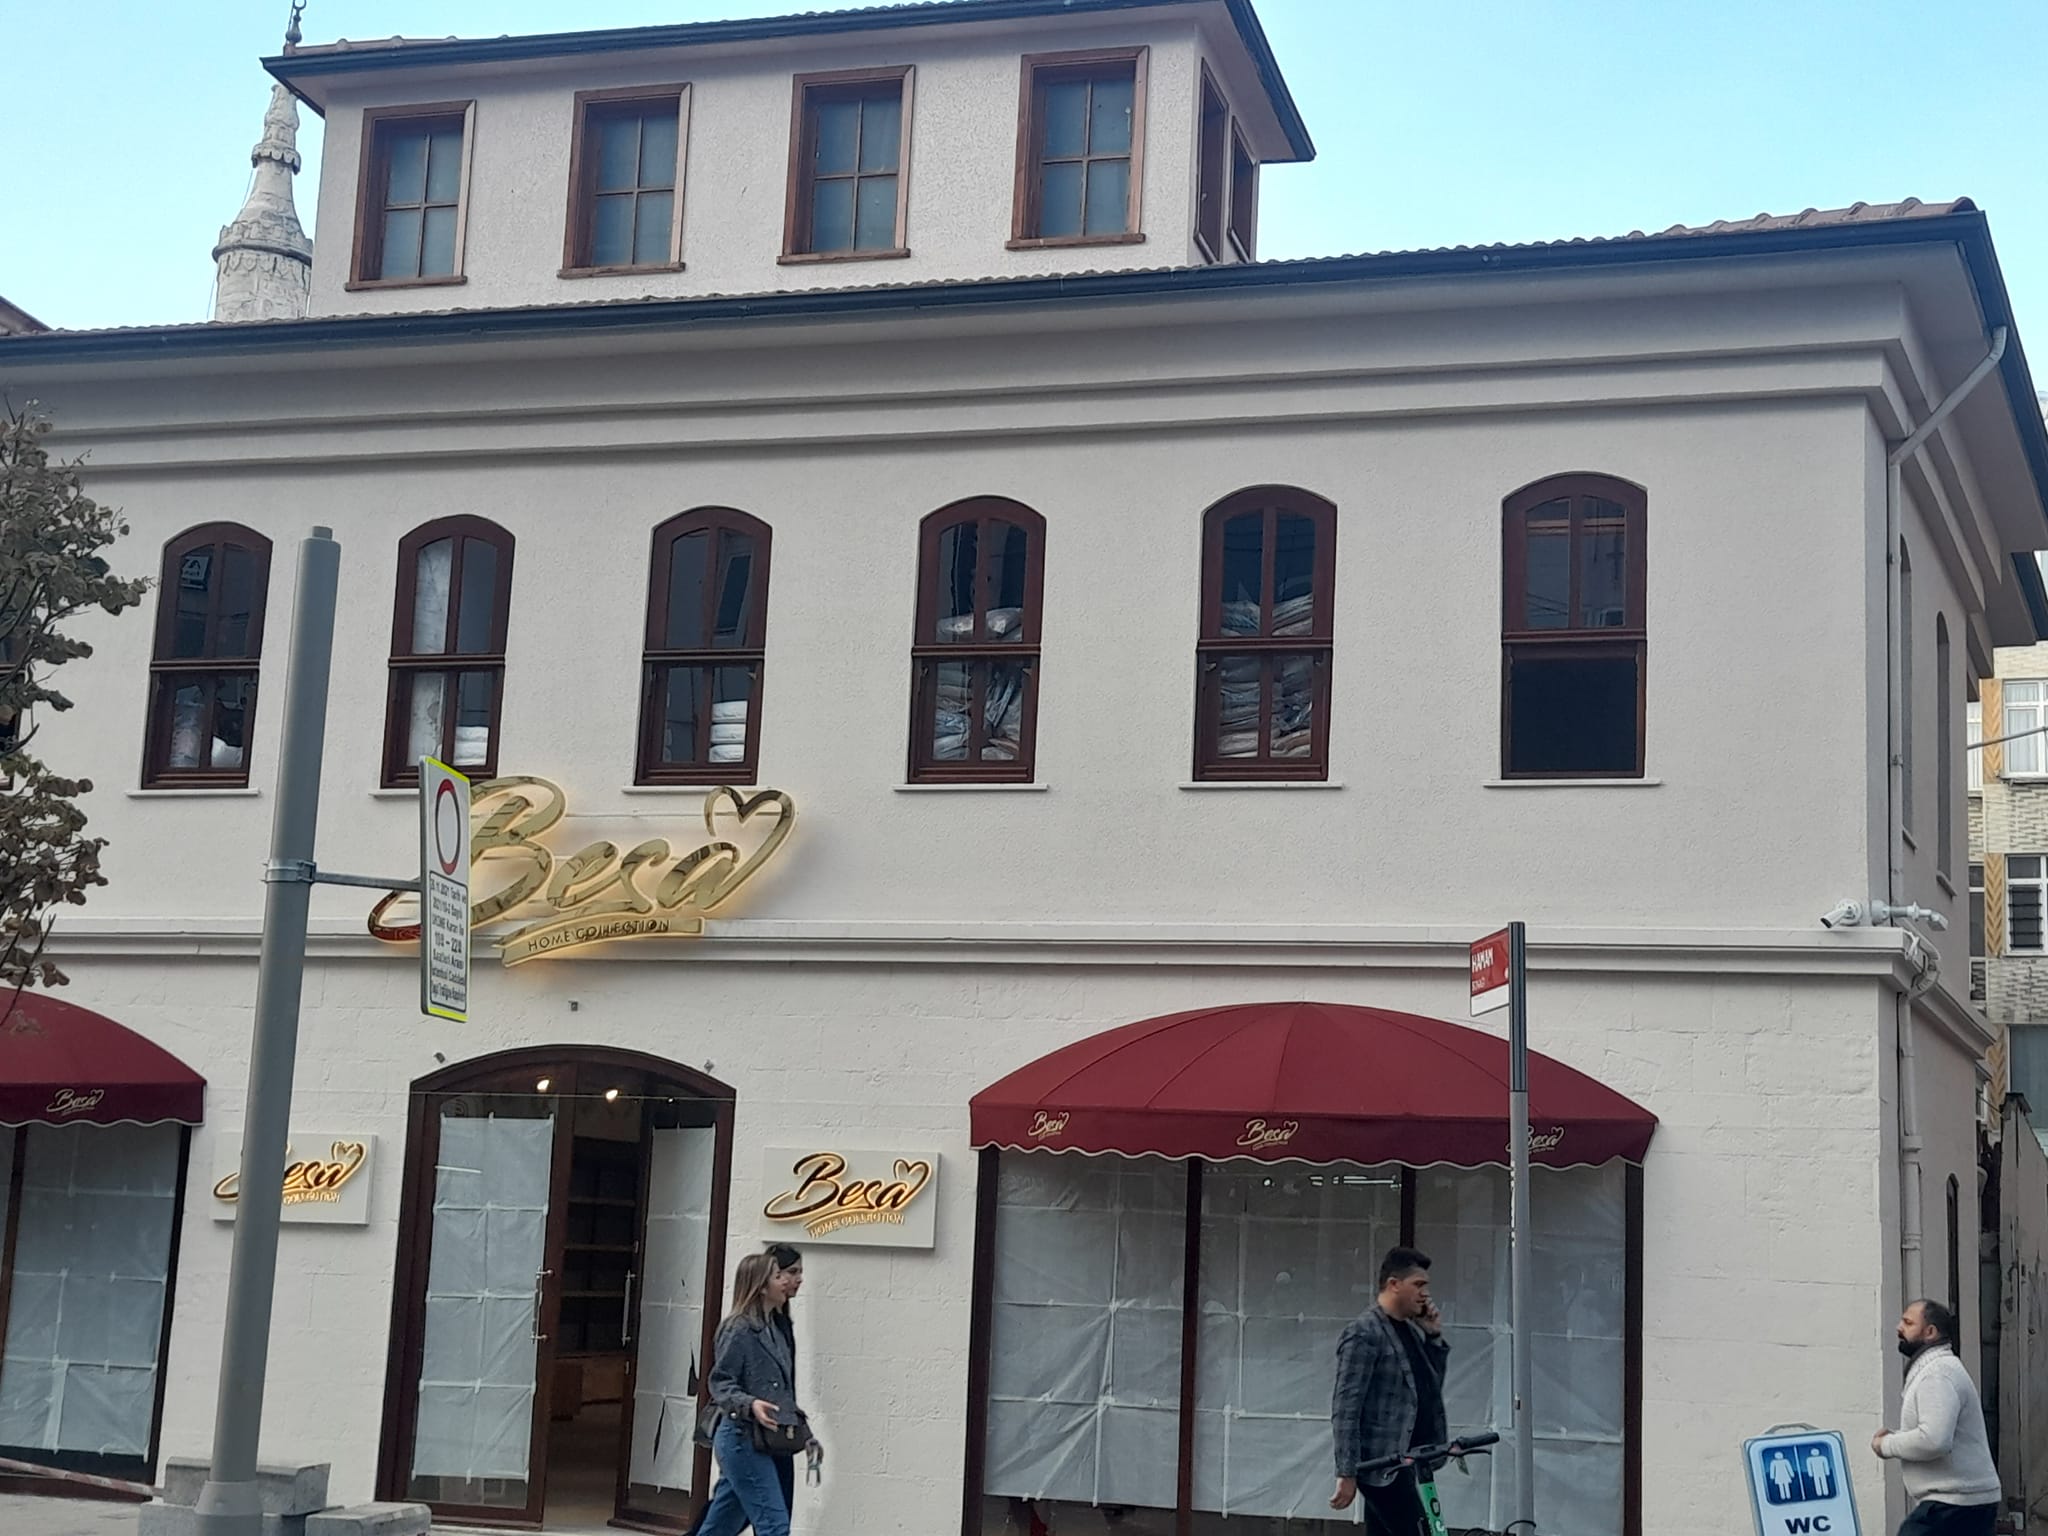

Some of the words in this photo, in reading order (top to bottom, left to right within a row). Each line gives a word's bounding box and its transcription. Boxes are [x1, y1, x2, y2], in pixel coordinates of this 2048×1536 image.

[368, 775, 796, 942] Besa
[528, 931, 572, 952] HOME
[574, 919, 671, 942] COLLECTION
[763, 1152, 931, 1219] Besa
[809, 1221, 840, 1240] HOME
[1784, 1515, 1832, 1535] WC
